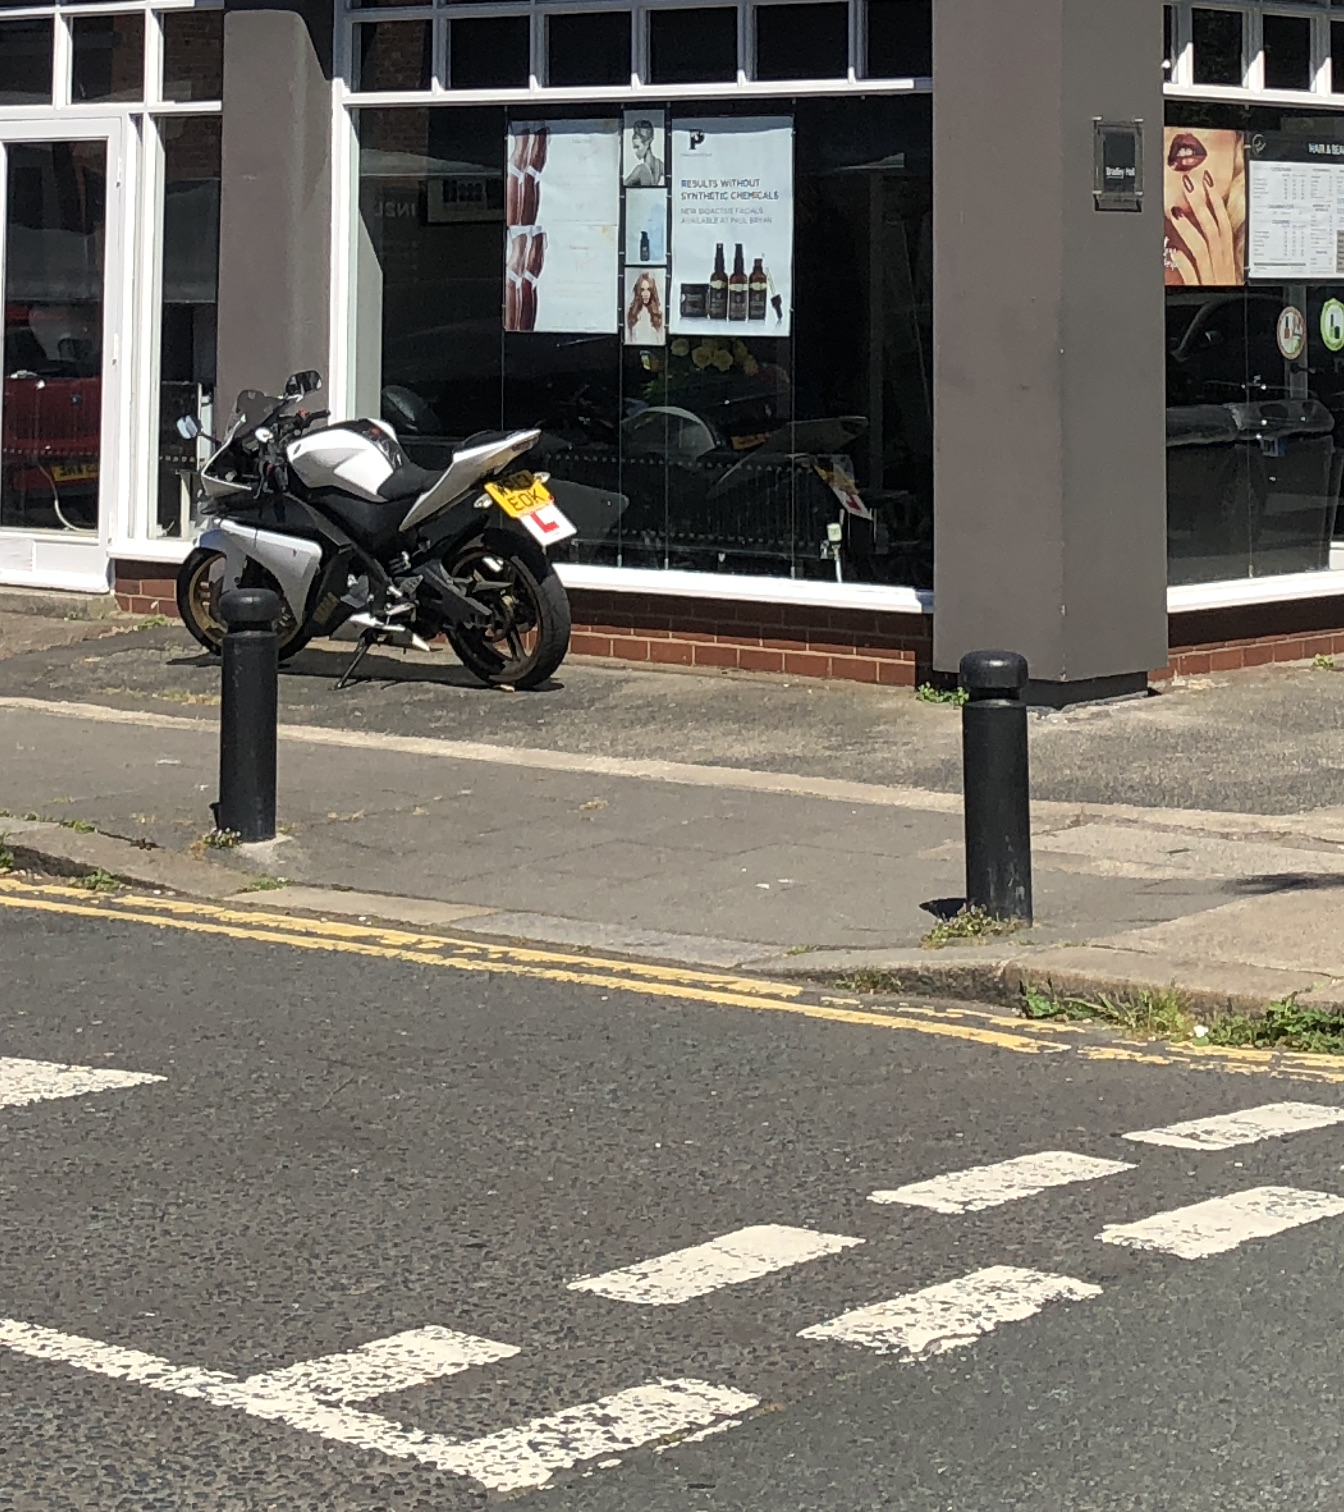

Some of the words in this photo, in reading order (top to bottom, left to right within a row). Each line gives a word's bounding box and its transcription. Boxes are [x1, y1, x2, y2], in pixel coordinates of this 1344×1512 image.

[681, 179, 718, 188] RESULTS
[720, 178, 760, 188] WITHOUT
[681, 191, 728, 201] SYNTHETIC
[730, 190, 779, 200] CHEMICALS
